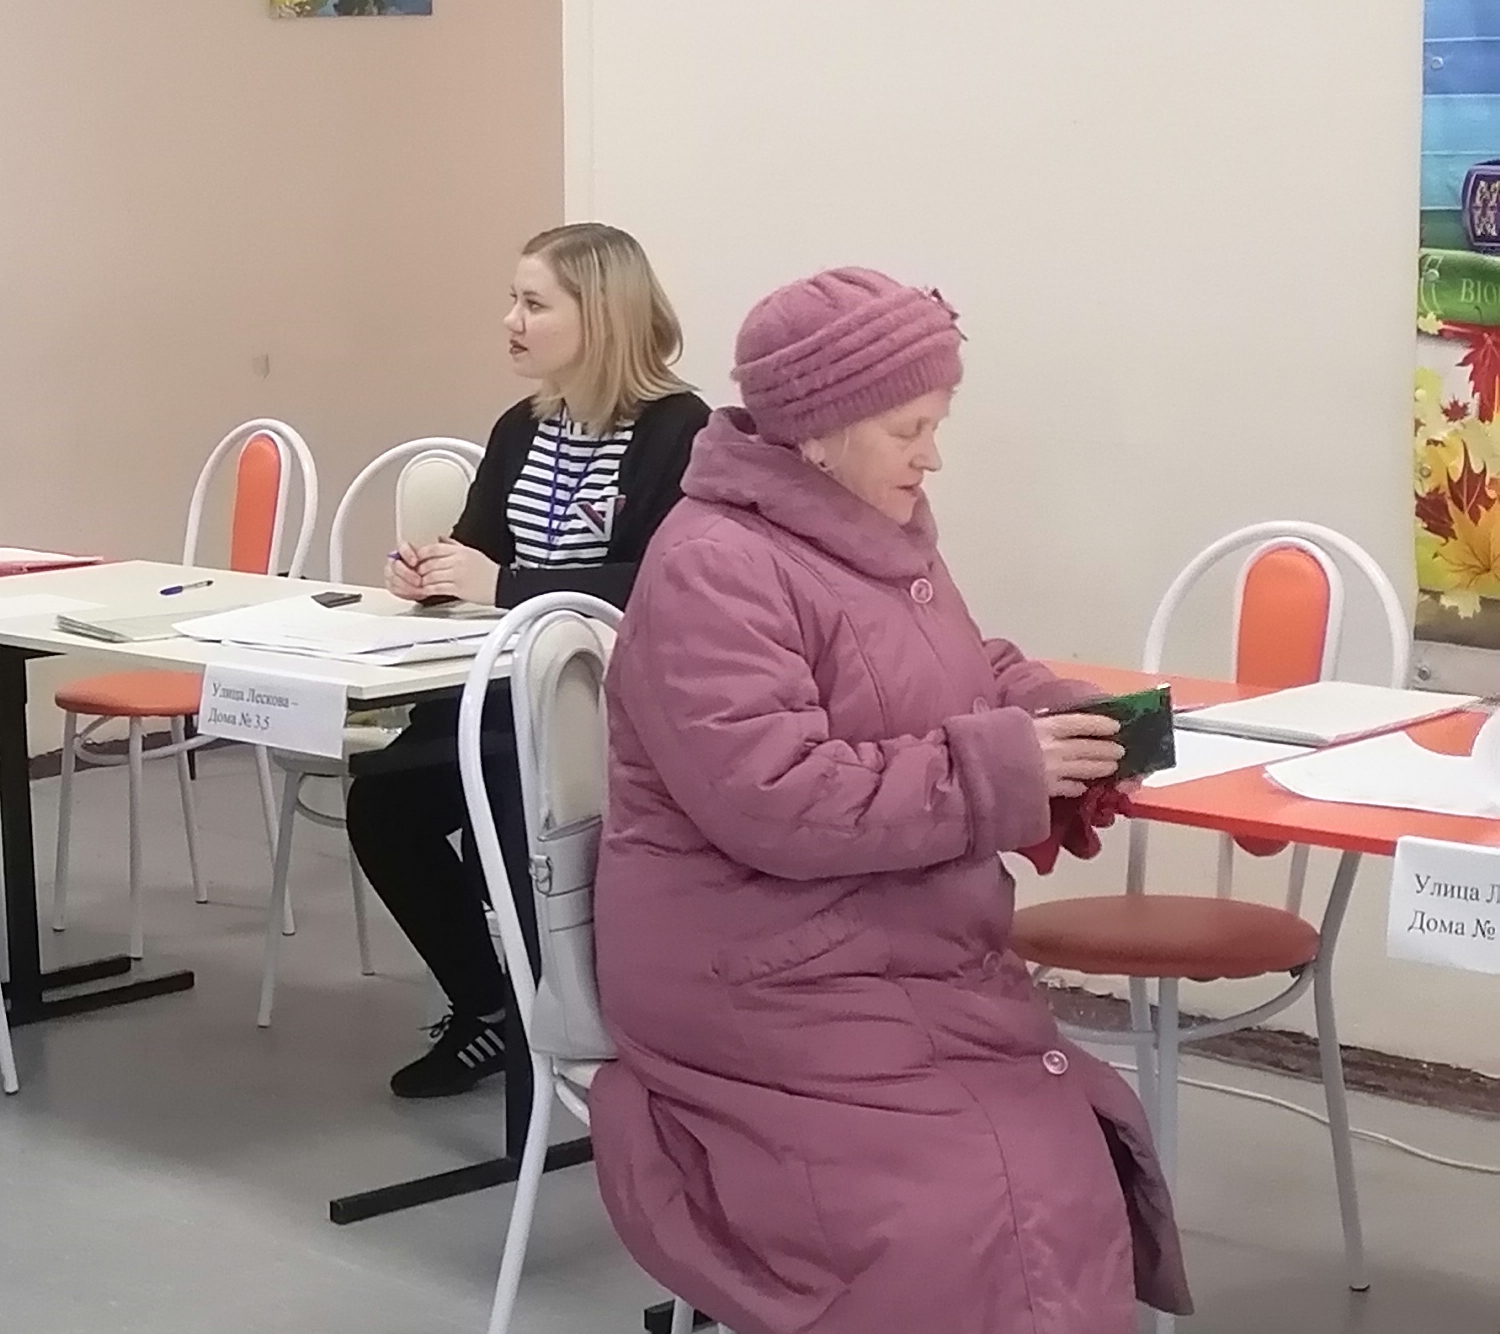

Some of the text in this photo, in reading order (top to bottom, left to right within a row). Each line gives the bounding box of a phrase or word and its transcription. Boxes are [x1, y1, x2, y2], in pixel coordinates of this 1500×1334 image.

[1460, 278, 1500, 305] BIO
[212, 682, 244, 701] Улица
[207, 707, 236, 725] Дома
[1414, 873, 1480, 902] Улица
[1407, 909, 1496, 940] Дома №
